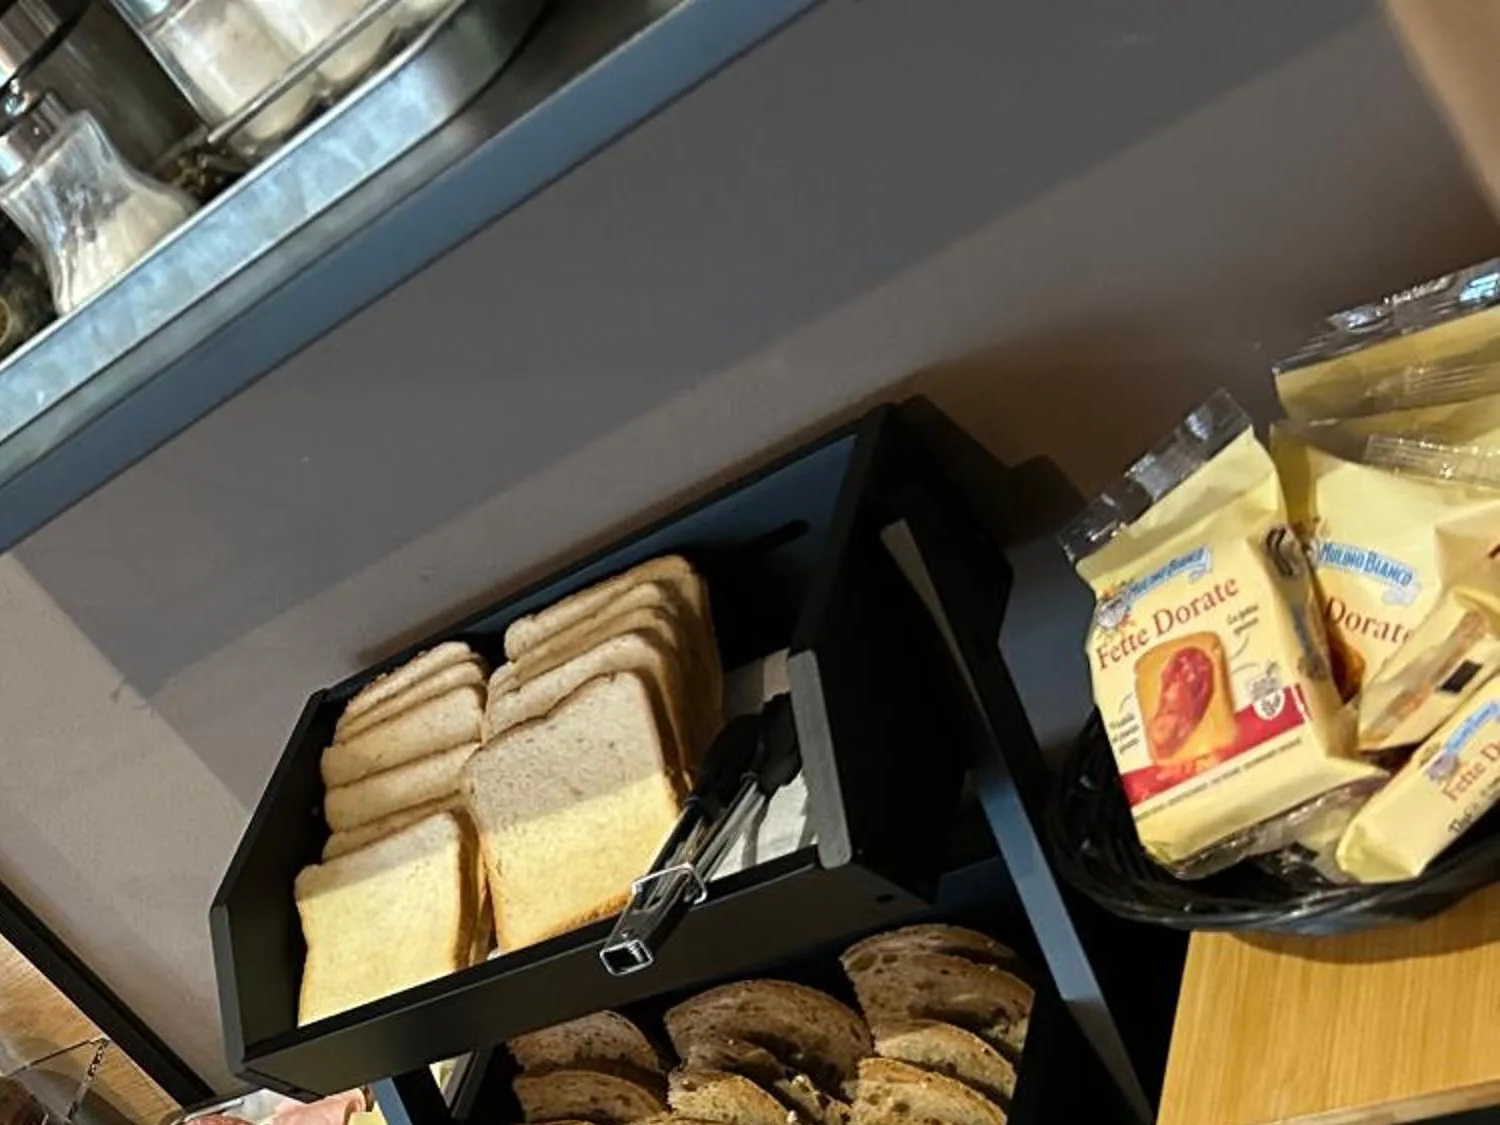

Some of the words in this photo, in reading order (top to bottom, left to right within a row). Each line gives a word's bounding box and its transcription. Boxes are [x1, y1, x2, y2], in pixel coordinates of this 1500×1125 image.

[1321, 542, 1366, 569] MULINO
[1363, 551, 1414, 587] BIANCO
[1095, 626, 1150, 670] Fette
[1151, 578, 1240, 637] Dorate
